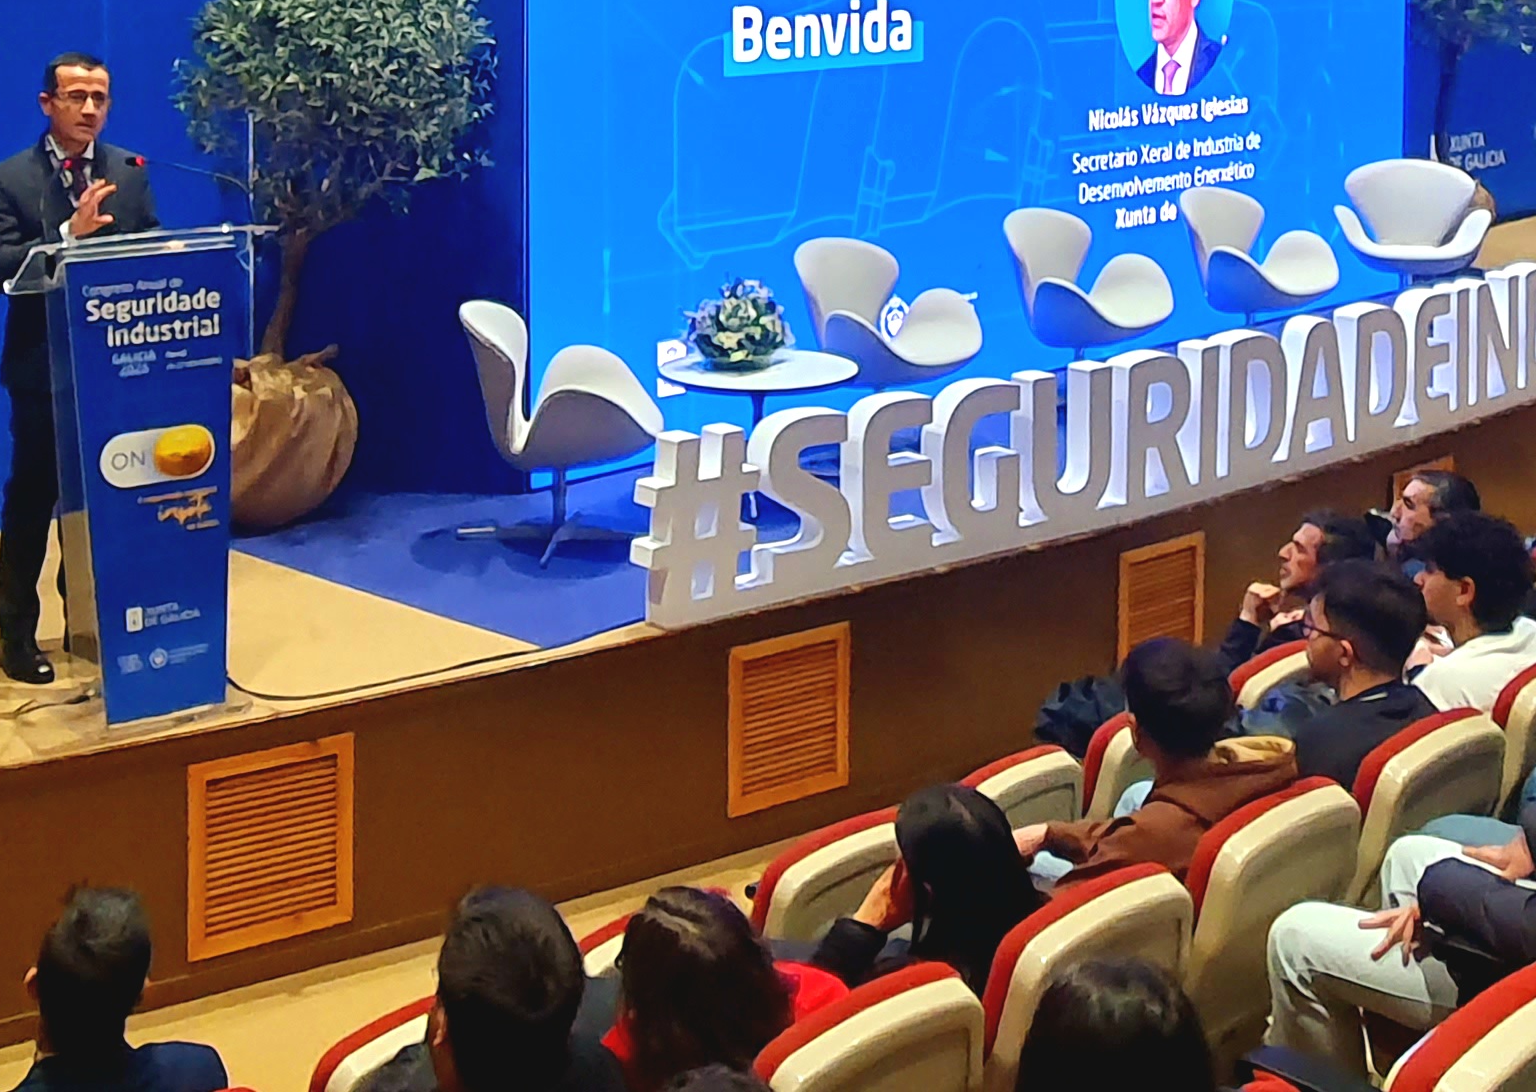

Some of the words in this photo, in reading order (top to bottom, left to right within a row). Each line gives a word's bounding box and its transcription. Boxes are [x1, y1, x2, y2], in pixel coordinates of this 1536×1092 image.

[1088, 106, 1138, 132] Nicolás
[1141, 102, 1198, 126] Vázquez
[1072, 147, 1138, 174] Secretario
[1140, 141, 1173, 165] Xeral
[1175, 140, 1191, 160] de
[1193, 133, 1244, 157] Industria
[1245, 131, 1262, 150] de
[1078, 171, 1192, 205] Desenvolvemento
[1115, 206, 1157, 230] Xunta
[1160, 200, 1178, 222] de
[85, 287, 221, 323] Seguridade
[107, 313, 220, 347] Industrial
[111, 450, 145, 471] ON
